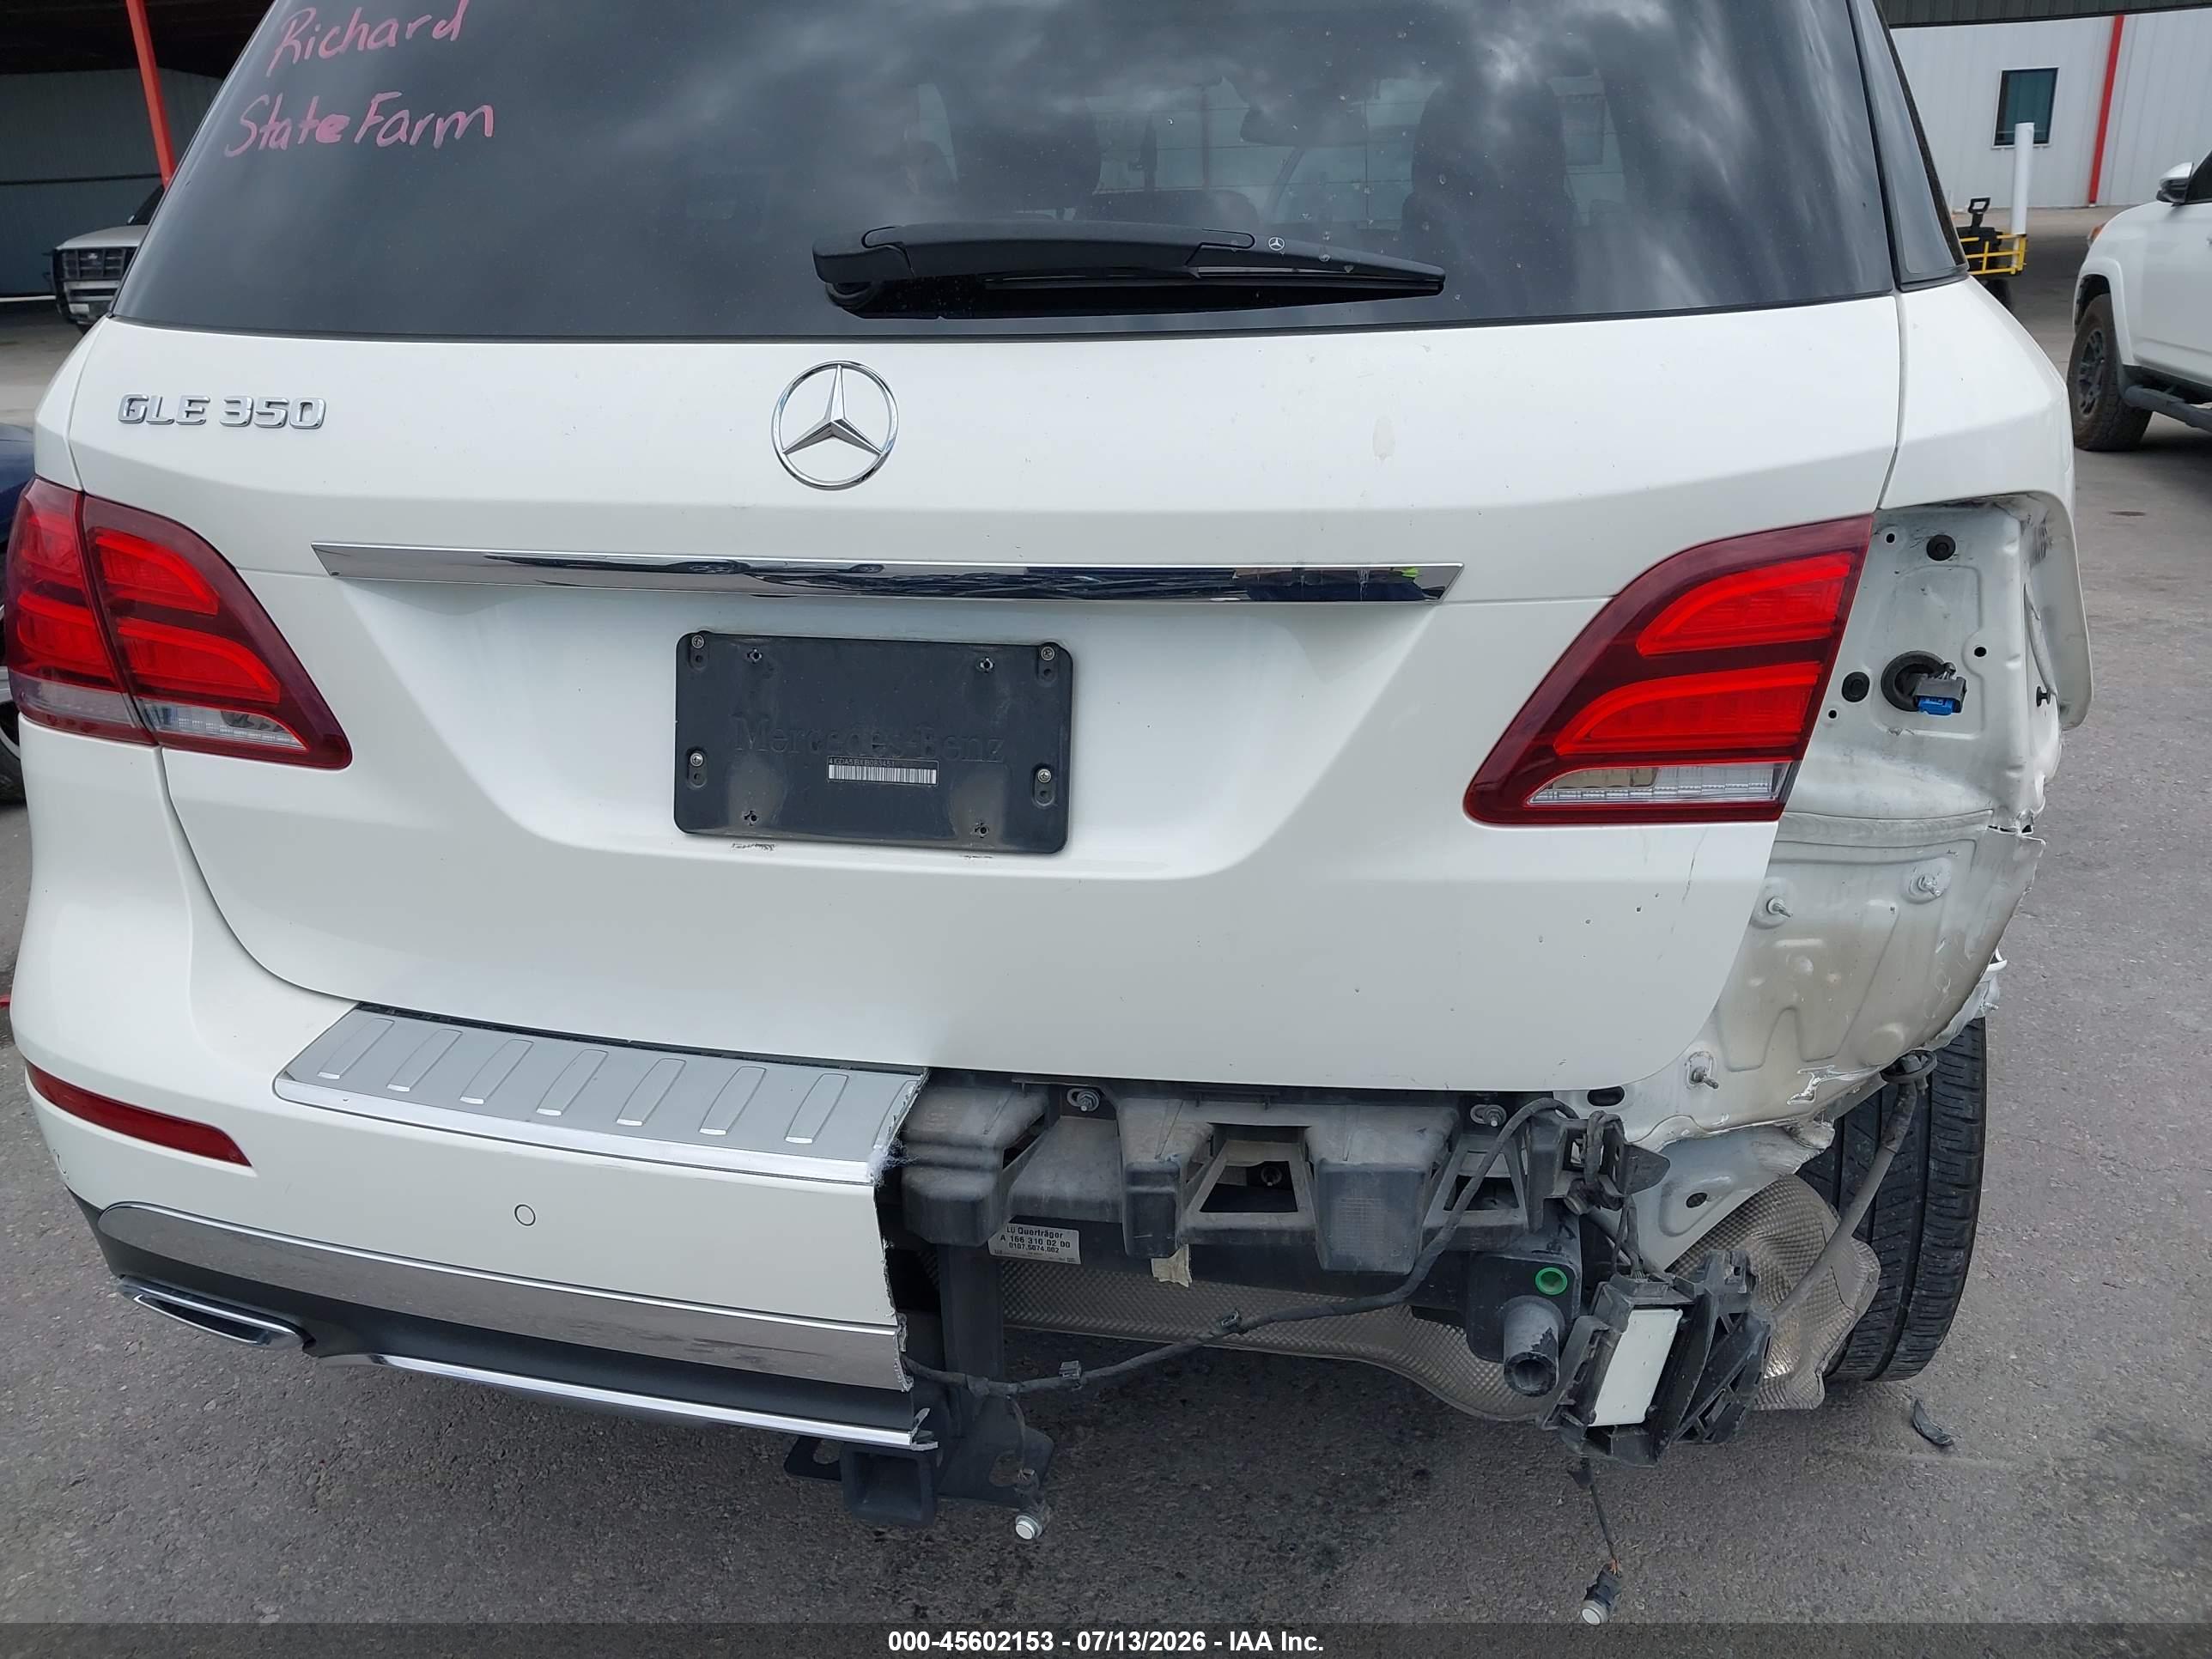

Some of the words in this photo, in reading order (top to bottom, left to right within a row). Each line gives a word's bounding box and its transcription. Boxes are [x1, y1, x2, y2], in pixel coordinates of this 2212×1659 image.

[267, 0, 468, 76] Richard
[117, 393, 210, 426] GLE
[220, 395, 326, 429] 350
[1028, 1237, 1043, 1245] 310
